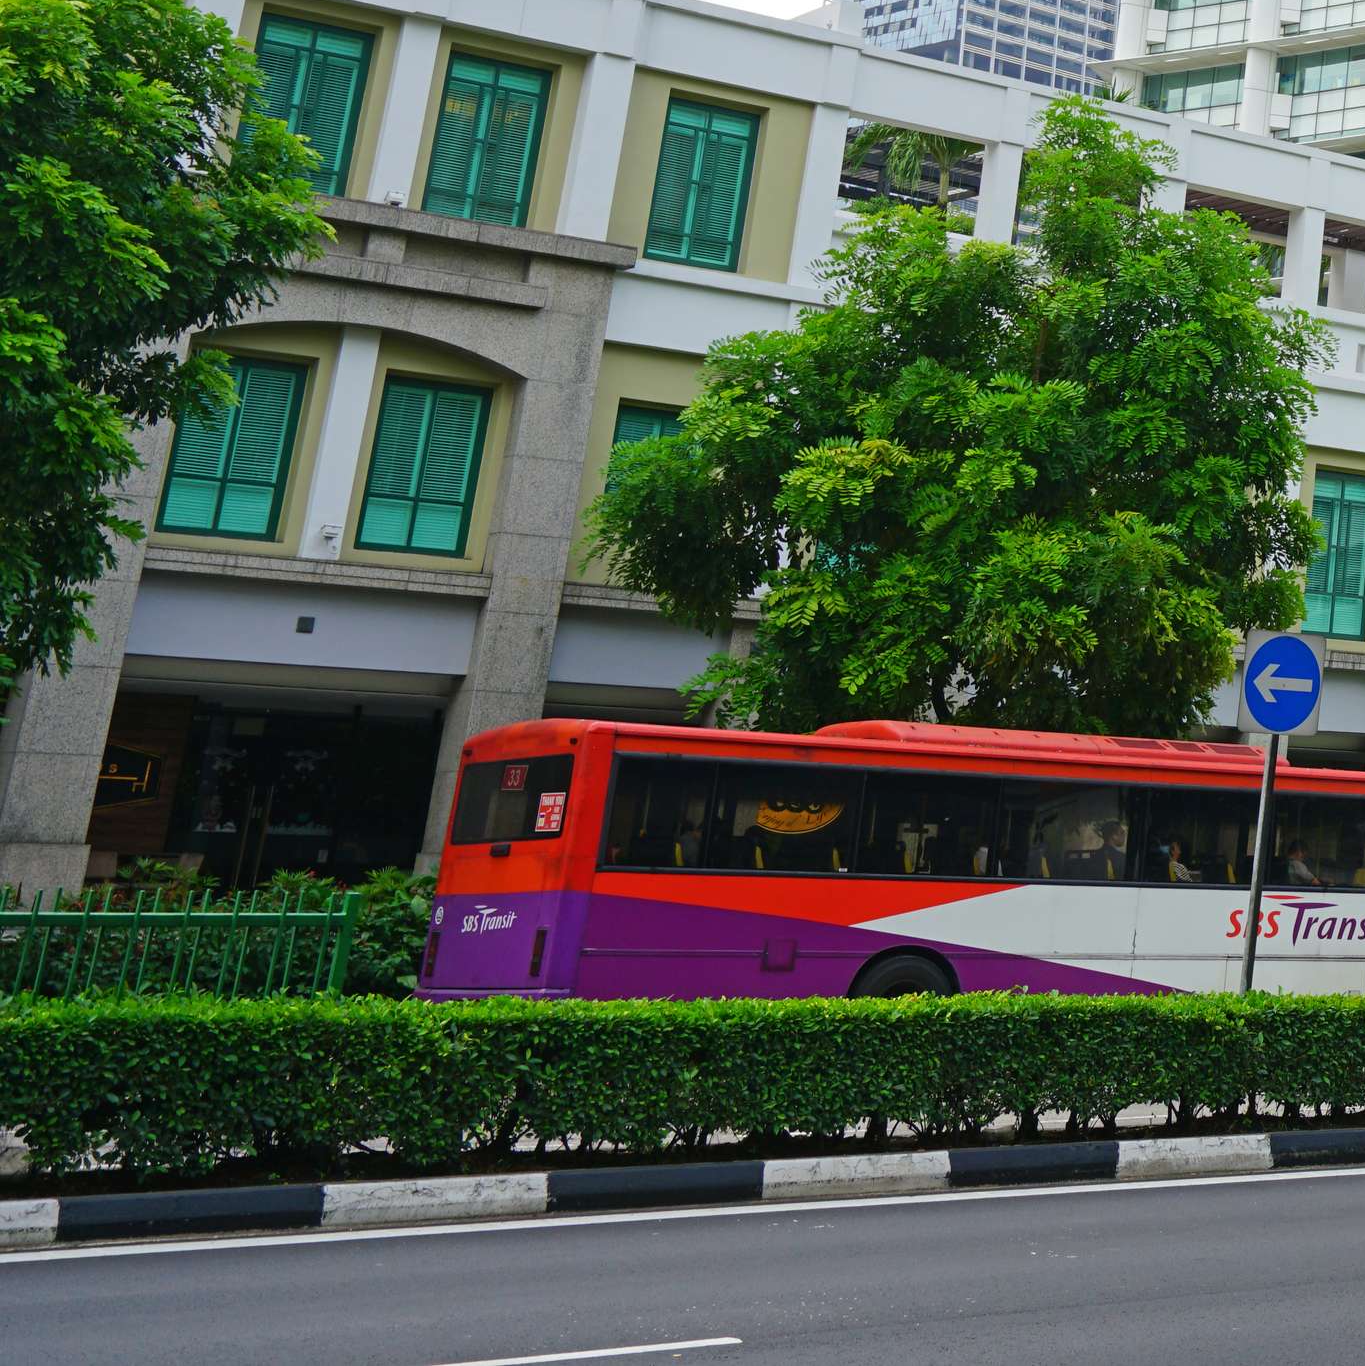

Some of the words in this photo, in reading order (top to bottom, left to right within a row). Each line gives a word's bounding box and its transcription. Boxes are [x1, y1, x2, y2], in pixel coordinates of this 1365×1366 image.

[507, 769, 521, 787] 33
[461, 914, 480, 933] SBS
[478, 907, 518, 935] Transit
